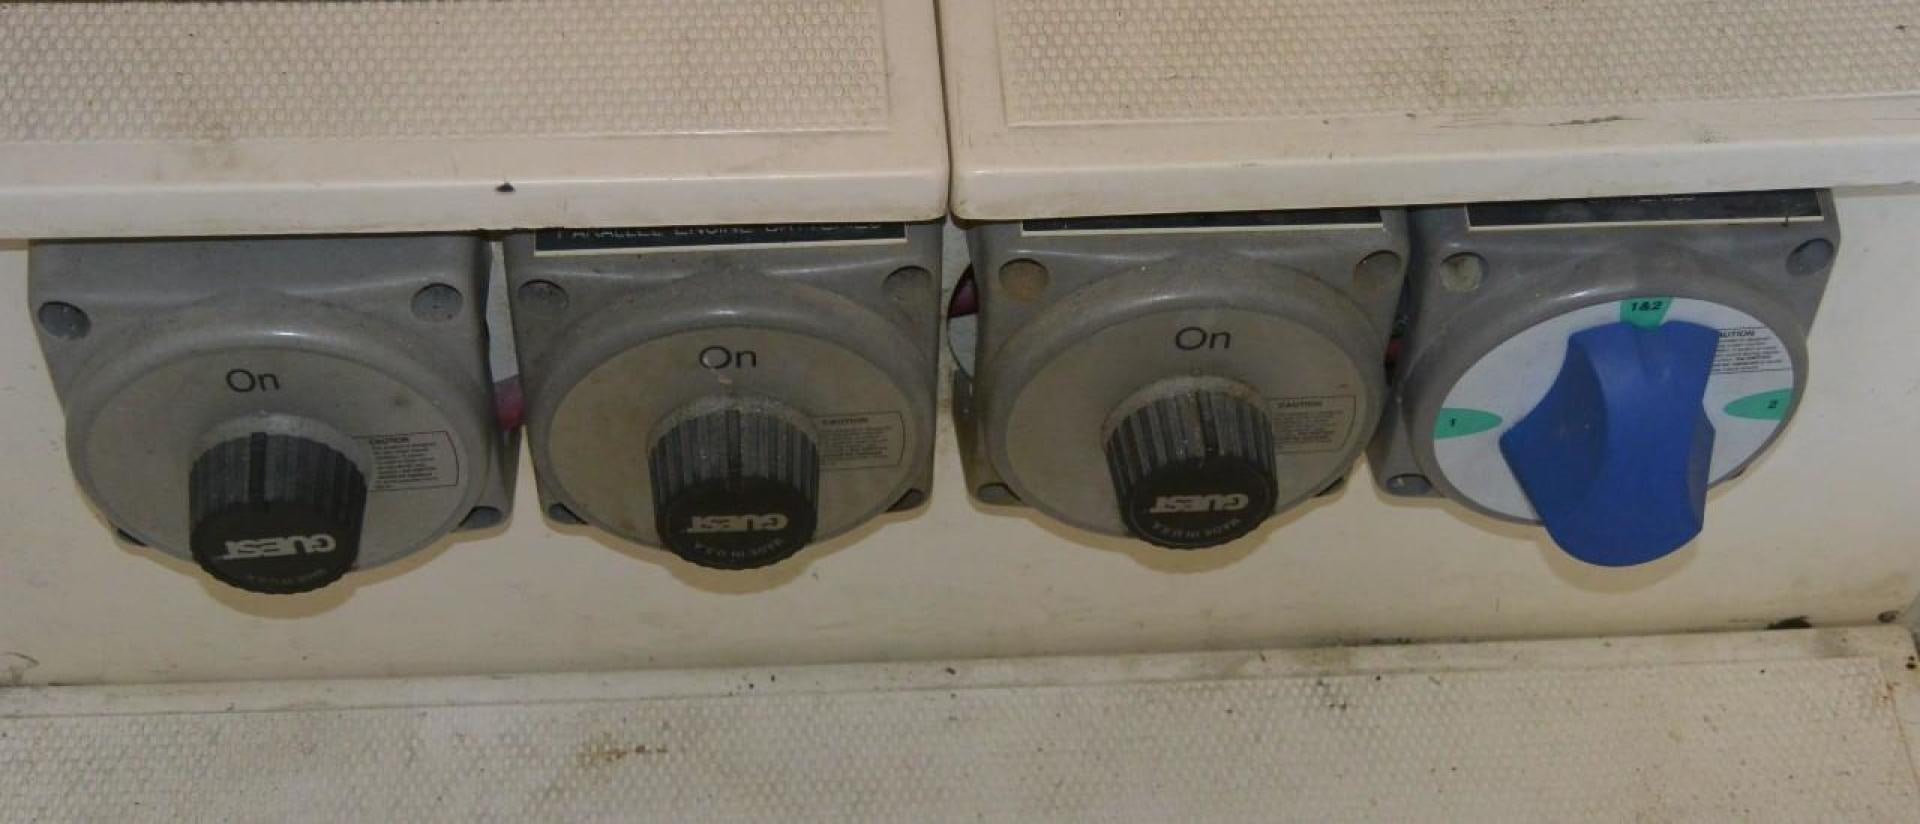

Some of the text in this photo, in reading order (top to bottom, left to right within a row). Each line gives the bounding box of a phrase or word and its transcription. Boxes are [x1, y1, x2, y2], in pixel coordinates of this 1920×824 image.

[1631, 301, 1663, 312] 1&2
[1175, 326, 1231, 350] On
[699, 345, 757, 370] On
[226, 368, 280, 393] On
[1767, 399, 1779, 409] 2
[1450, 418, 1457, 428] 1
[1149, 493, 1249, 513] GUEST
[681, 513, 788, 533] GUEST
[213, 533, 337, 560] GUEST
